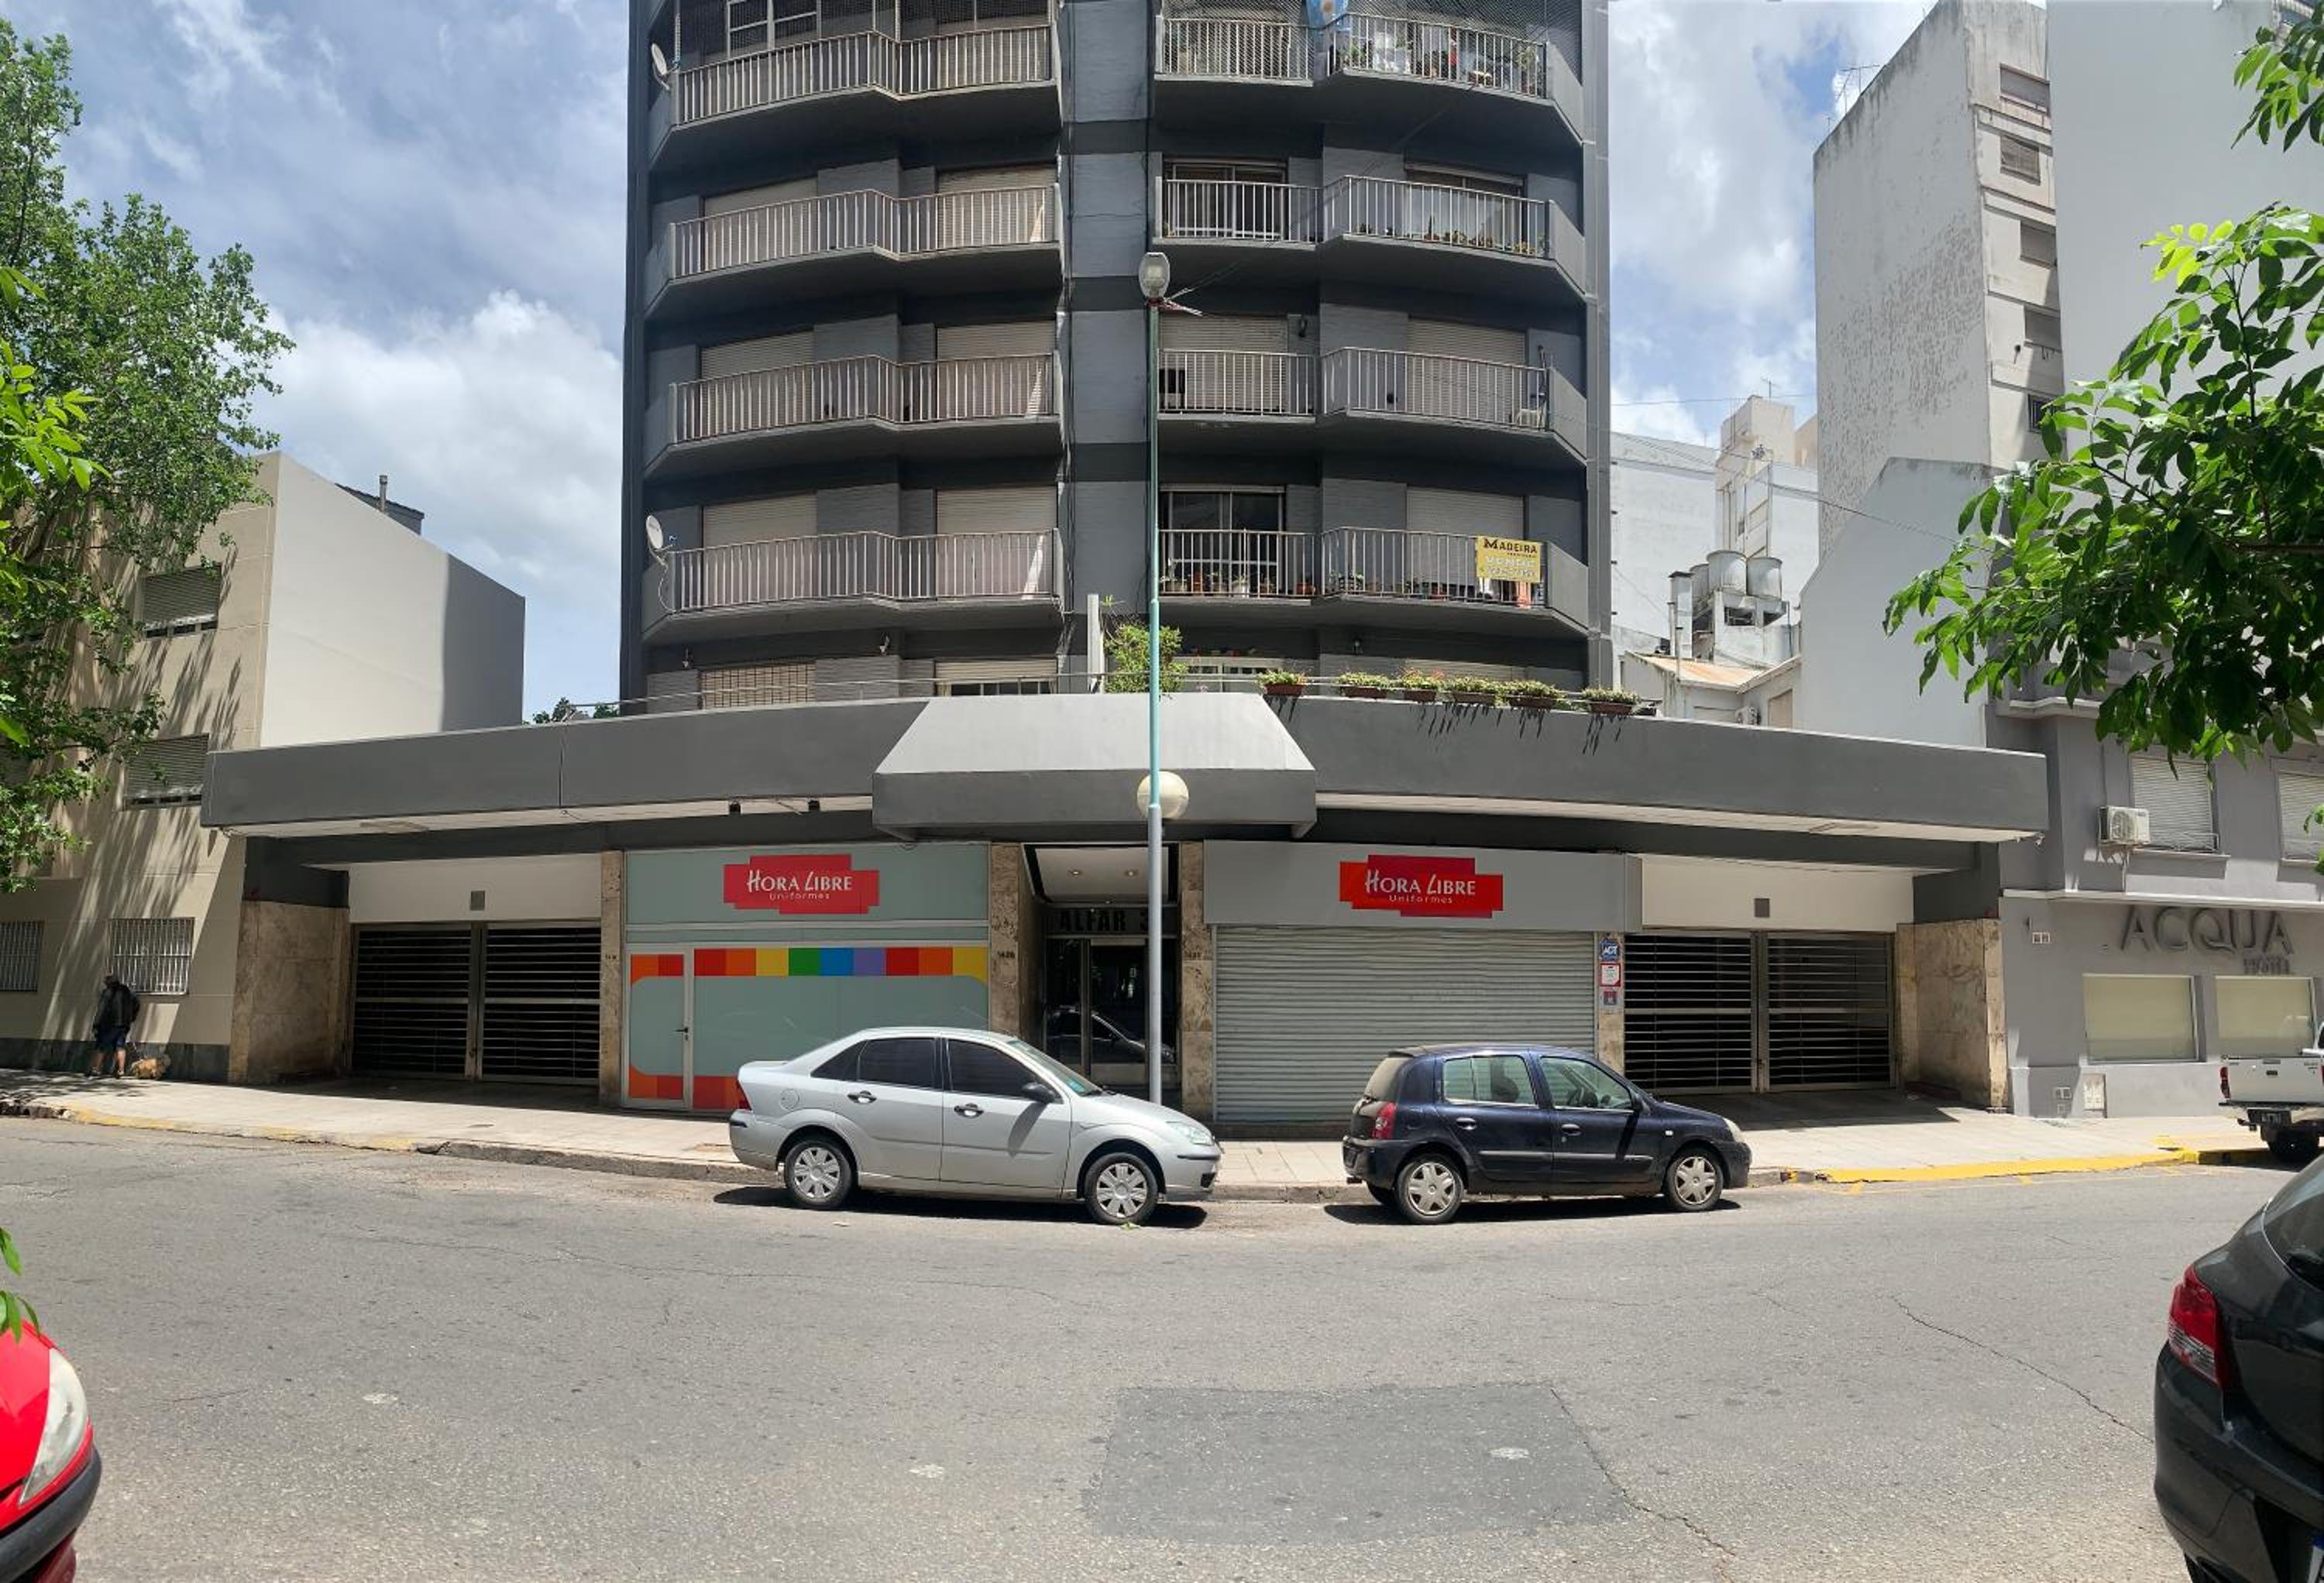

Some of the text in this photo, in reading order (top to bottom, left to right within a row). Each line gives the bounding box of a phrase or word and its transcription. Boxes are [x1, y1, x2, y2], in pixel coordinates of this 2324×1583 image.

[1483, 538, 1537, 554] MADEIRA
[747, 869, 853, 892] HORA LIBRE
[1365, 868, 1476, 895] HORA LIBRE
[1389, 895, 1452, 904] Uniformes
[2119, 905, 2294, 954] ACQUA
